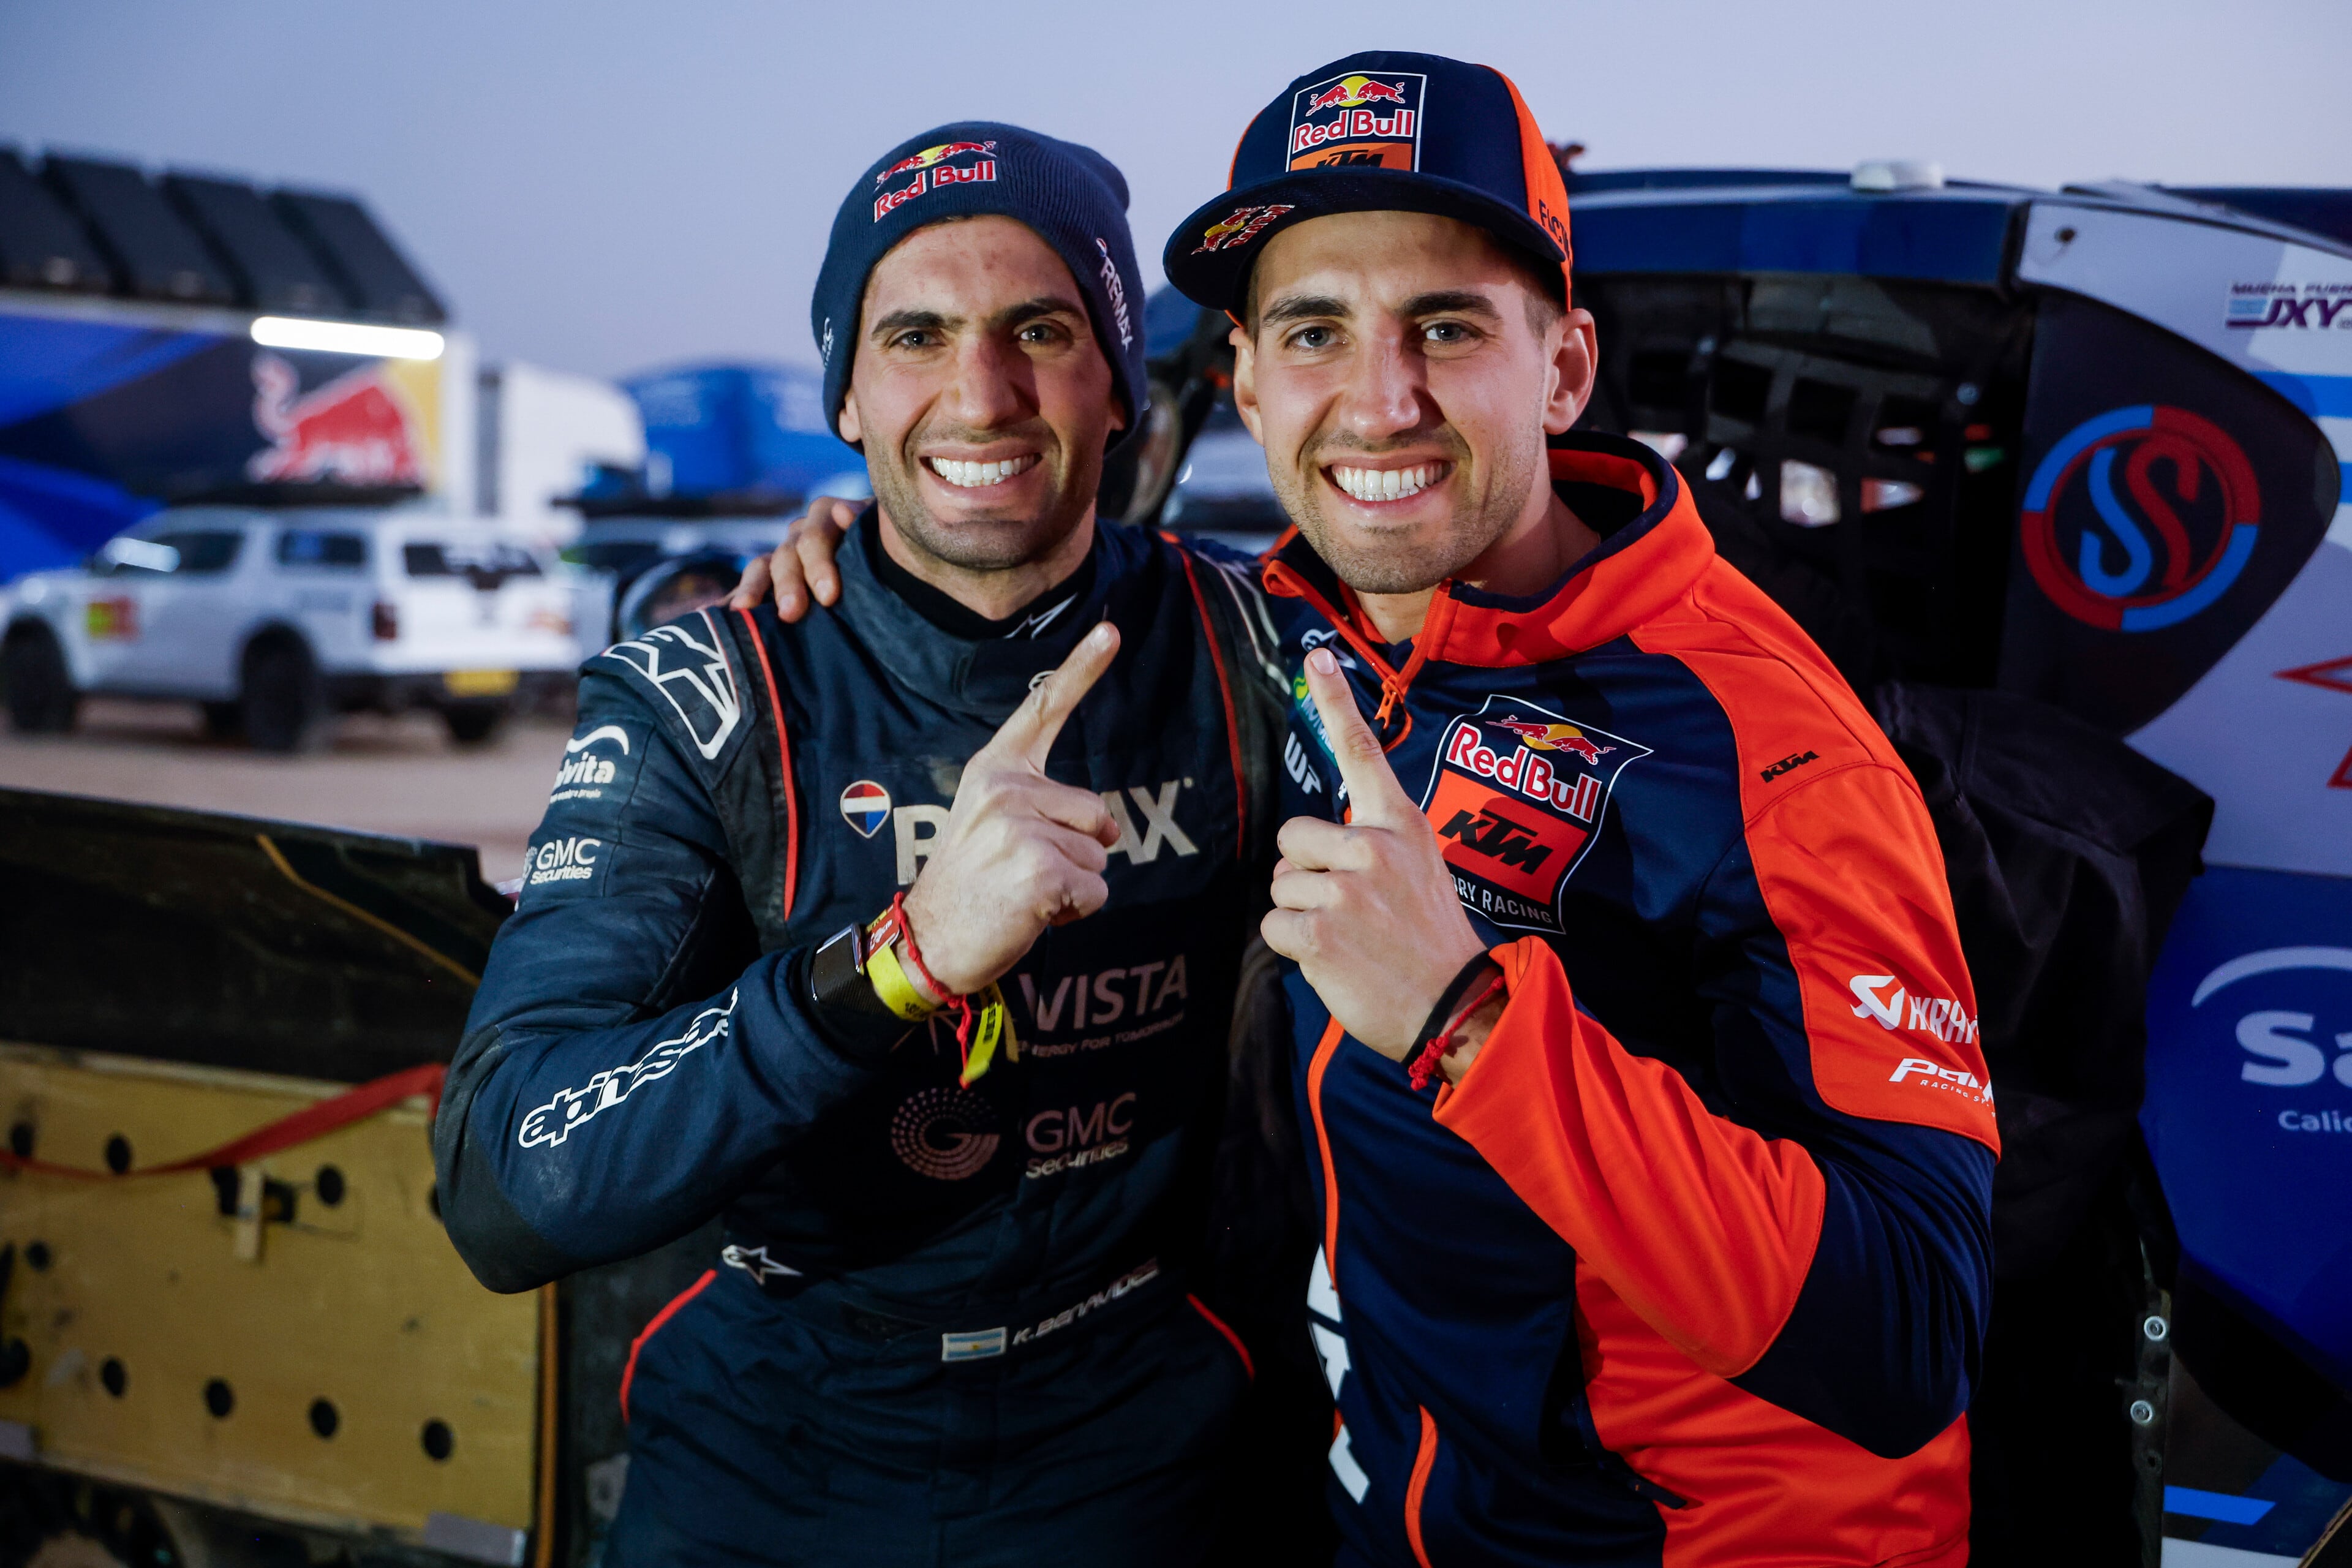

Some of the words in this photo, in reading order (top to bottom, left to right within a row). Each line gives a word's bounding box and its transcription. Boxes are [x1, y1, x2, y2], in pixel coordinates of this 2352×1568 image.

[1292, 109, 1349, 154] Red
[1350, 109, 1415, 138] Bull
[874, 170, 927, 223] Red
[932, 161, 997, 189] Bull
[1446, 722, 1529, 791] Red
[1522, 753, 1602, 824] Bull
[1760, 750, 1820, 783] KTM
[537, 837, 601, 870] GMC
[1438, 809, 1554, 875] KTM
[1482, 889, 1553, 924] RACING
[1018, 954, 1188, 1032] VISTA
[1025, 1091, 1137, 1153] GMC
